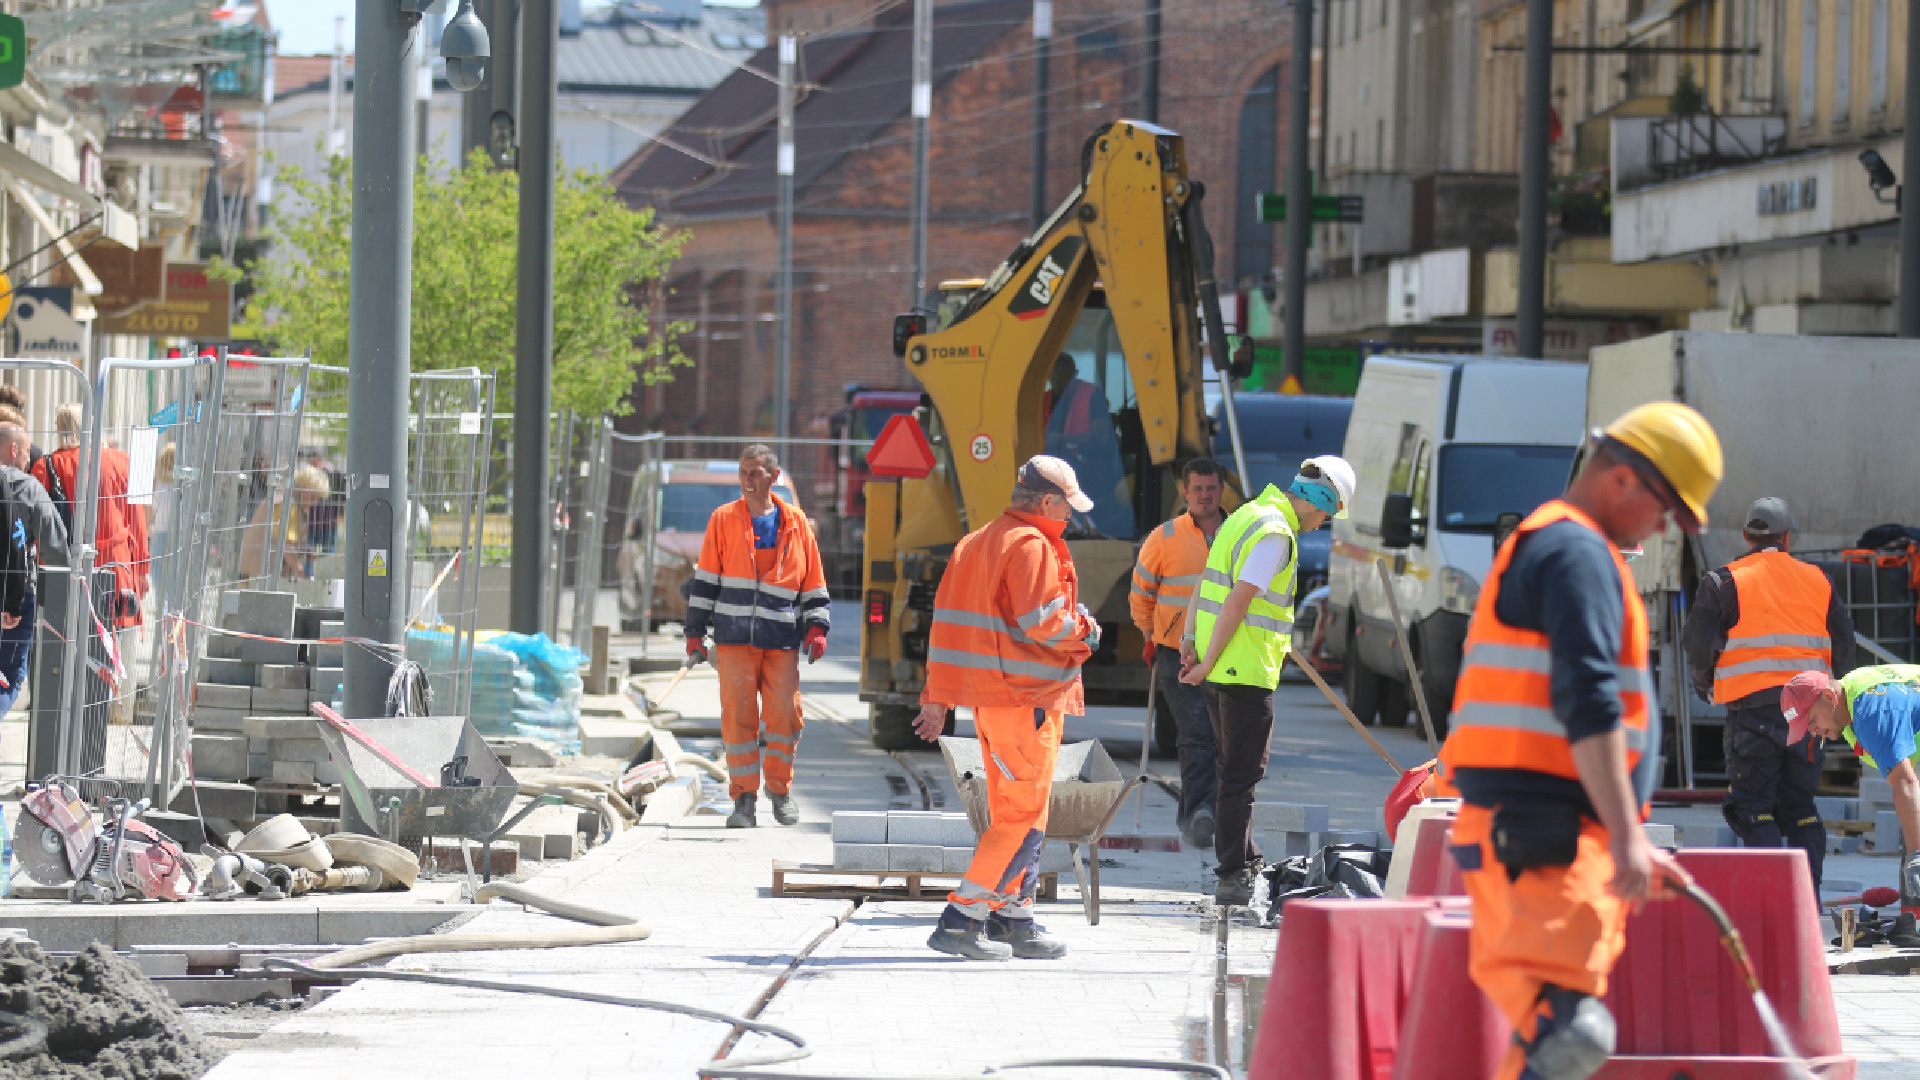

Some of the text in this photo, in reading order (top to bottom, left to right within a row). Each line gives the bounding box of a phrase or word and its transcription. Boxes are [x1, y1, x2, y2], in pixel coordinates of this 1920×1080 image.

[1030, 254, 1064, 304] CAT
[931, 345, 985, 358] TORMEL
[975, 441, 989, 455] 25
